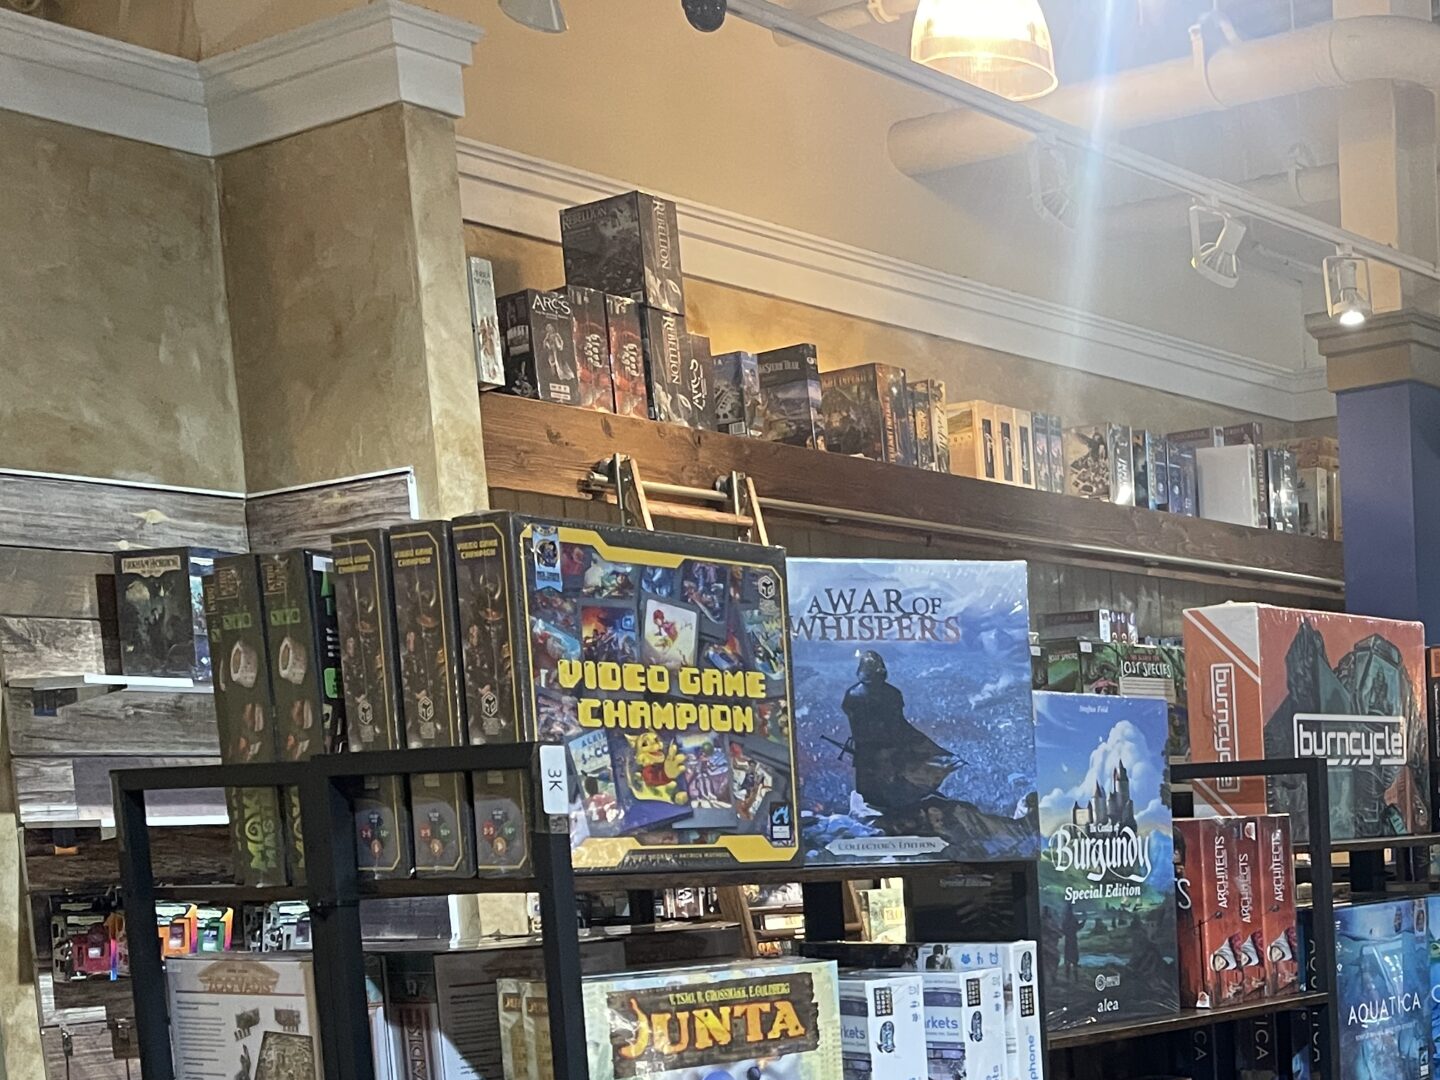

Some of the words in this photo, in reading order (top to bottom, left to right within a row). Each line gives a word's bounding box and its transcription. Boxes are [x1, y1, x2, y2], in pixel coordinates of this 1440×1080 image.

[652, 200, 671, 270] REBELLION
[662, 314, 680, 384] REBELLION
[807, 595, 823, 615] A
[825, 588, 906, 616] WAR
[912, 597, 942, 616] OF
[788, 615, 961, 643] WHISPERS
[557, 659, 670, 694] VIDEO
[678, 667, 767, 699] GAME
[1121, 660, 1141, 678] LOST
[1142, 660, 1172, 678] SPECIES
[576, 697, 755, 734] CHAMPION
[1215, 668, 1234, 788] burncyce
[1299, 724, 1402, 762] burncycle
[837, 841, 897, 851] COLLECTOR'S
[899, 840, 937, 850] EDITION
[1049, 824, 1152, 883] Burgundy
[1215, 835, 1229, 909] ARCHITECTS
[1271, 828, 1285, 902] ARCHITECTS
[1065, 885, 1103, 904] Special
[1105, 883, 1141, 899] Edition
[1238, 853, 1251, 923] ARCHITECTS
[1097, 998, 1119, 1013] alea
[1347, 991, 1422, 1027] AQUATICA
[618, 998, 805, 1060] JUNTA
[840, 1026, 866, 1040] rkets
